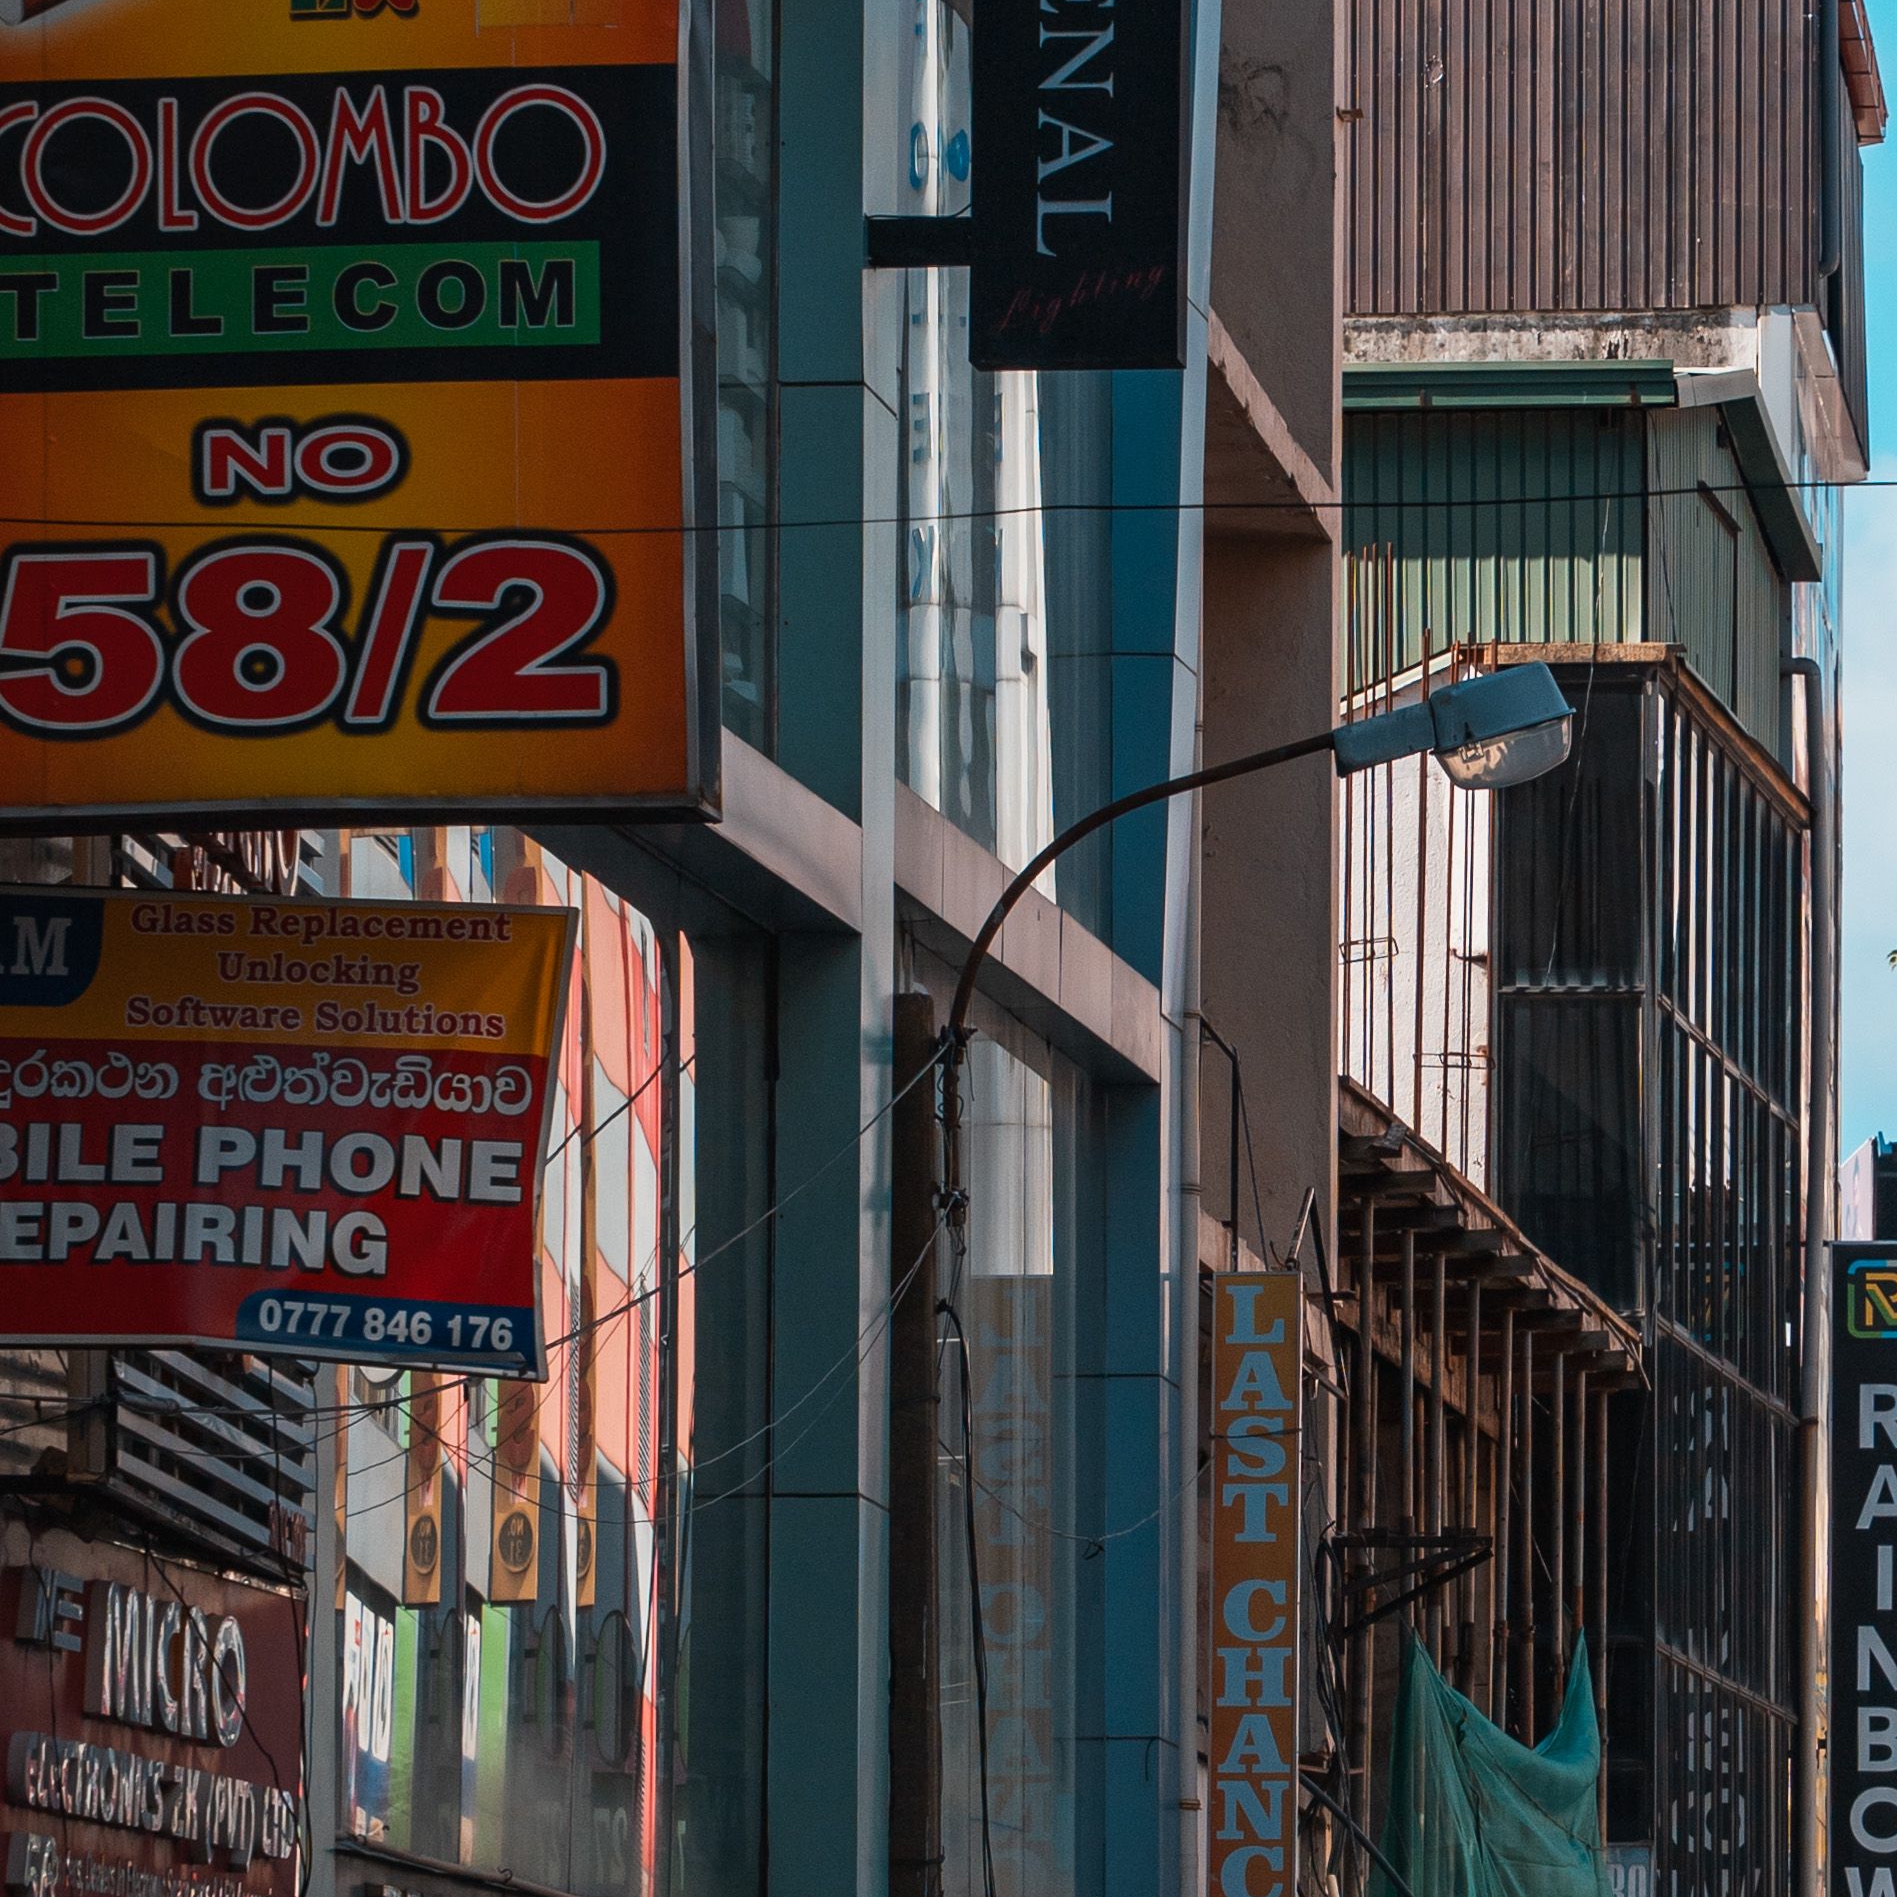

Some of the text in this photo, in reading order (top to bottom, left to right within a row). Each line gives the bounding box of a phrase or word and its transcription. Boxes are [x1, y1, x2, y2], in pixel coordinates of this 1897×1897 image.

[202, 424, 400, 497] NO
[0, 540, 607, 730] 58/2
[131, 903, 512, 946] Glass Replacement
[216, 952, 420, 995] Unlocking
[125, 996, 506, 1041] Software Solutions
[198, 1125, 523, 1202] PHONE
[259, 1298, 513, 1352] 0777 846 176
[1220, 1284, 1292, 1543] LAST
[100, 1581, 247, 1748] MICRO
